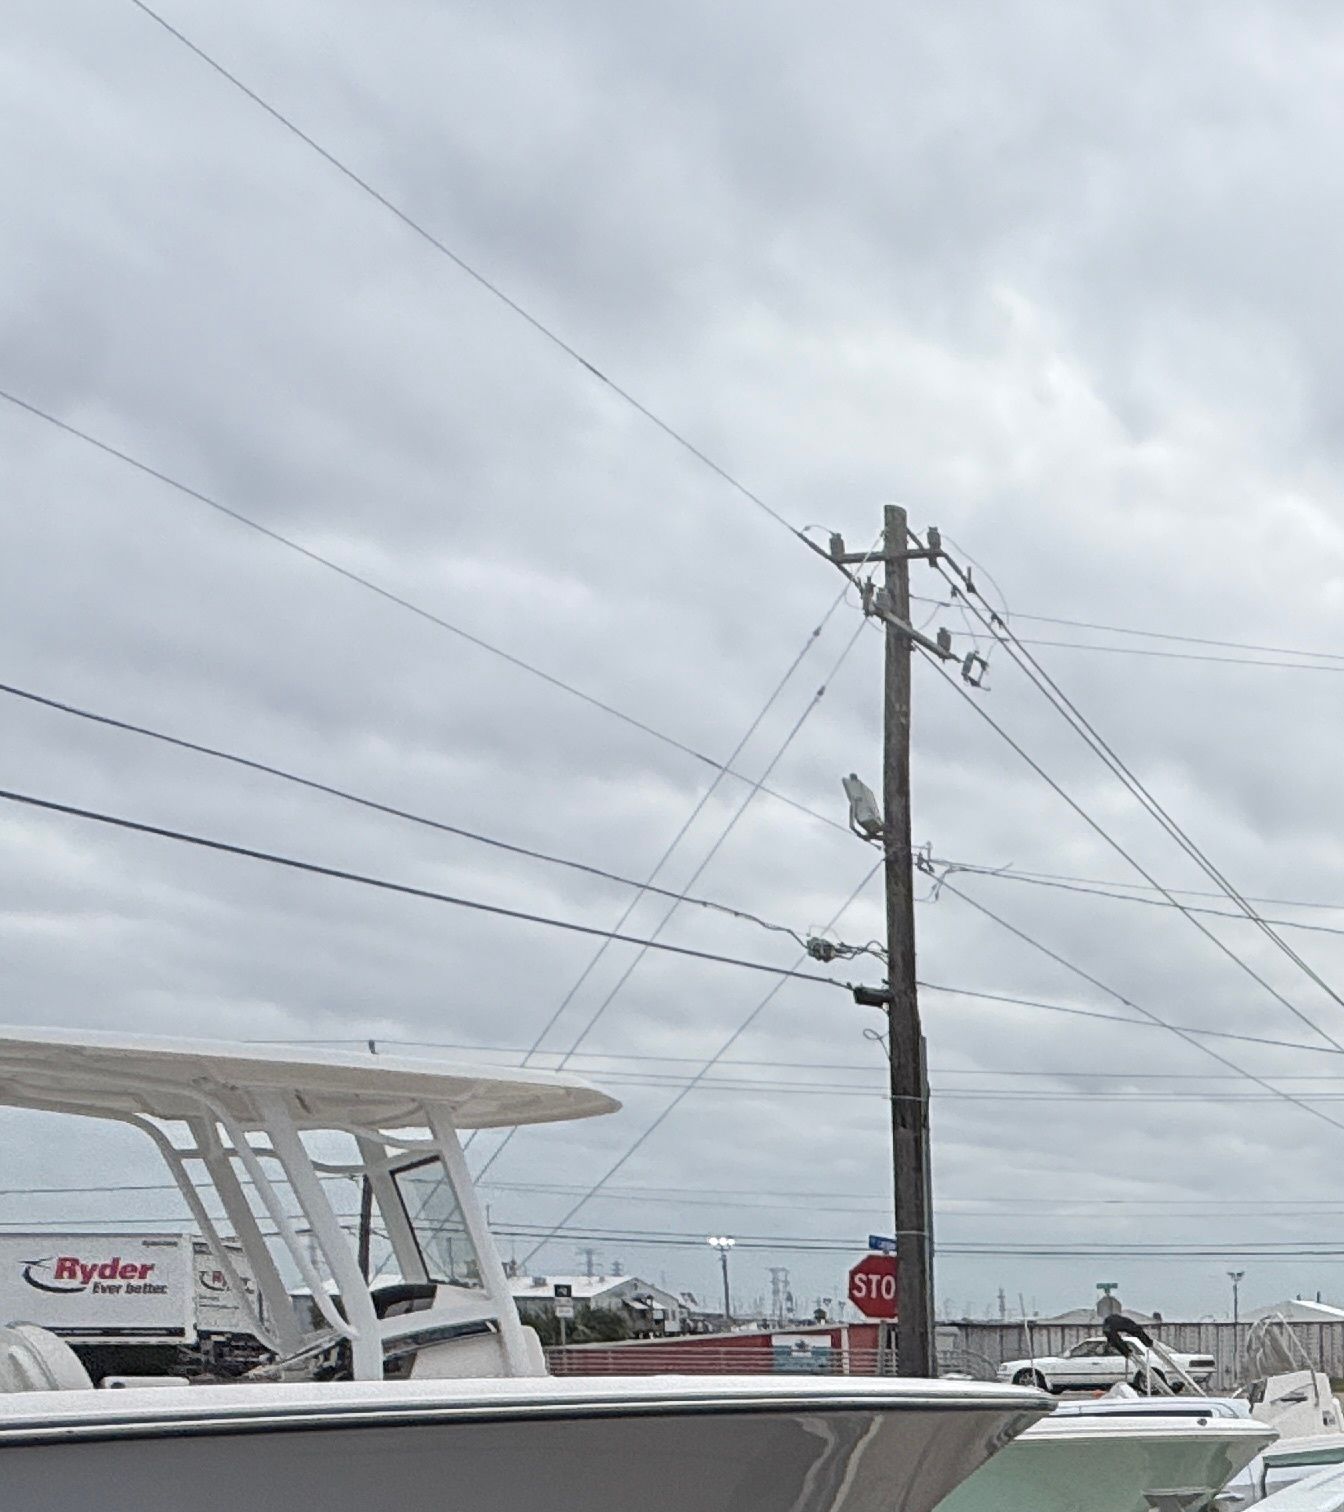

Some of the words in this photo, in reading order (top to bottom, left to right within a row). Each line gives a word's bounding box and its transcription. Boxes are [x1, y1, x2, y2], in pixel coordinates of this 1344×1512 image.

[54, 1256, 156, 1285] Ryder
[92, 1282, 123, 1294] Ever
[853, 1273, 896, 1299] STO
